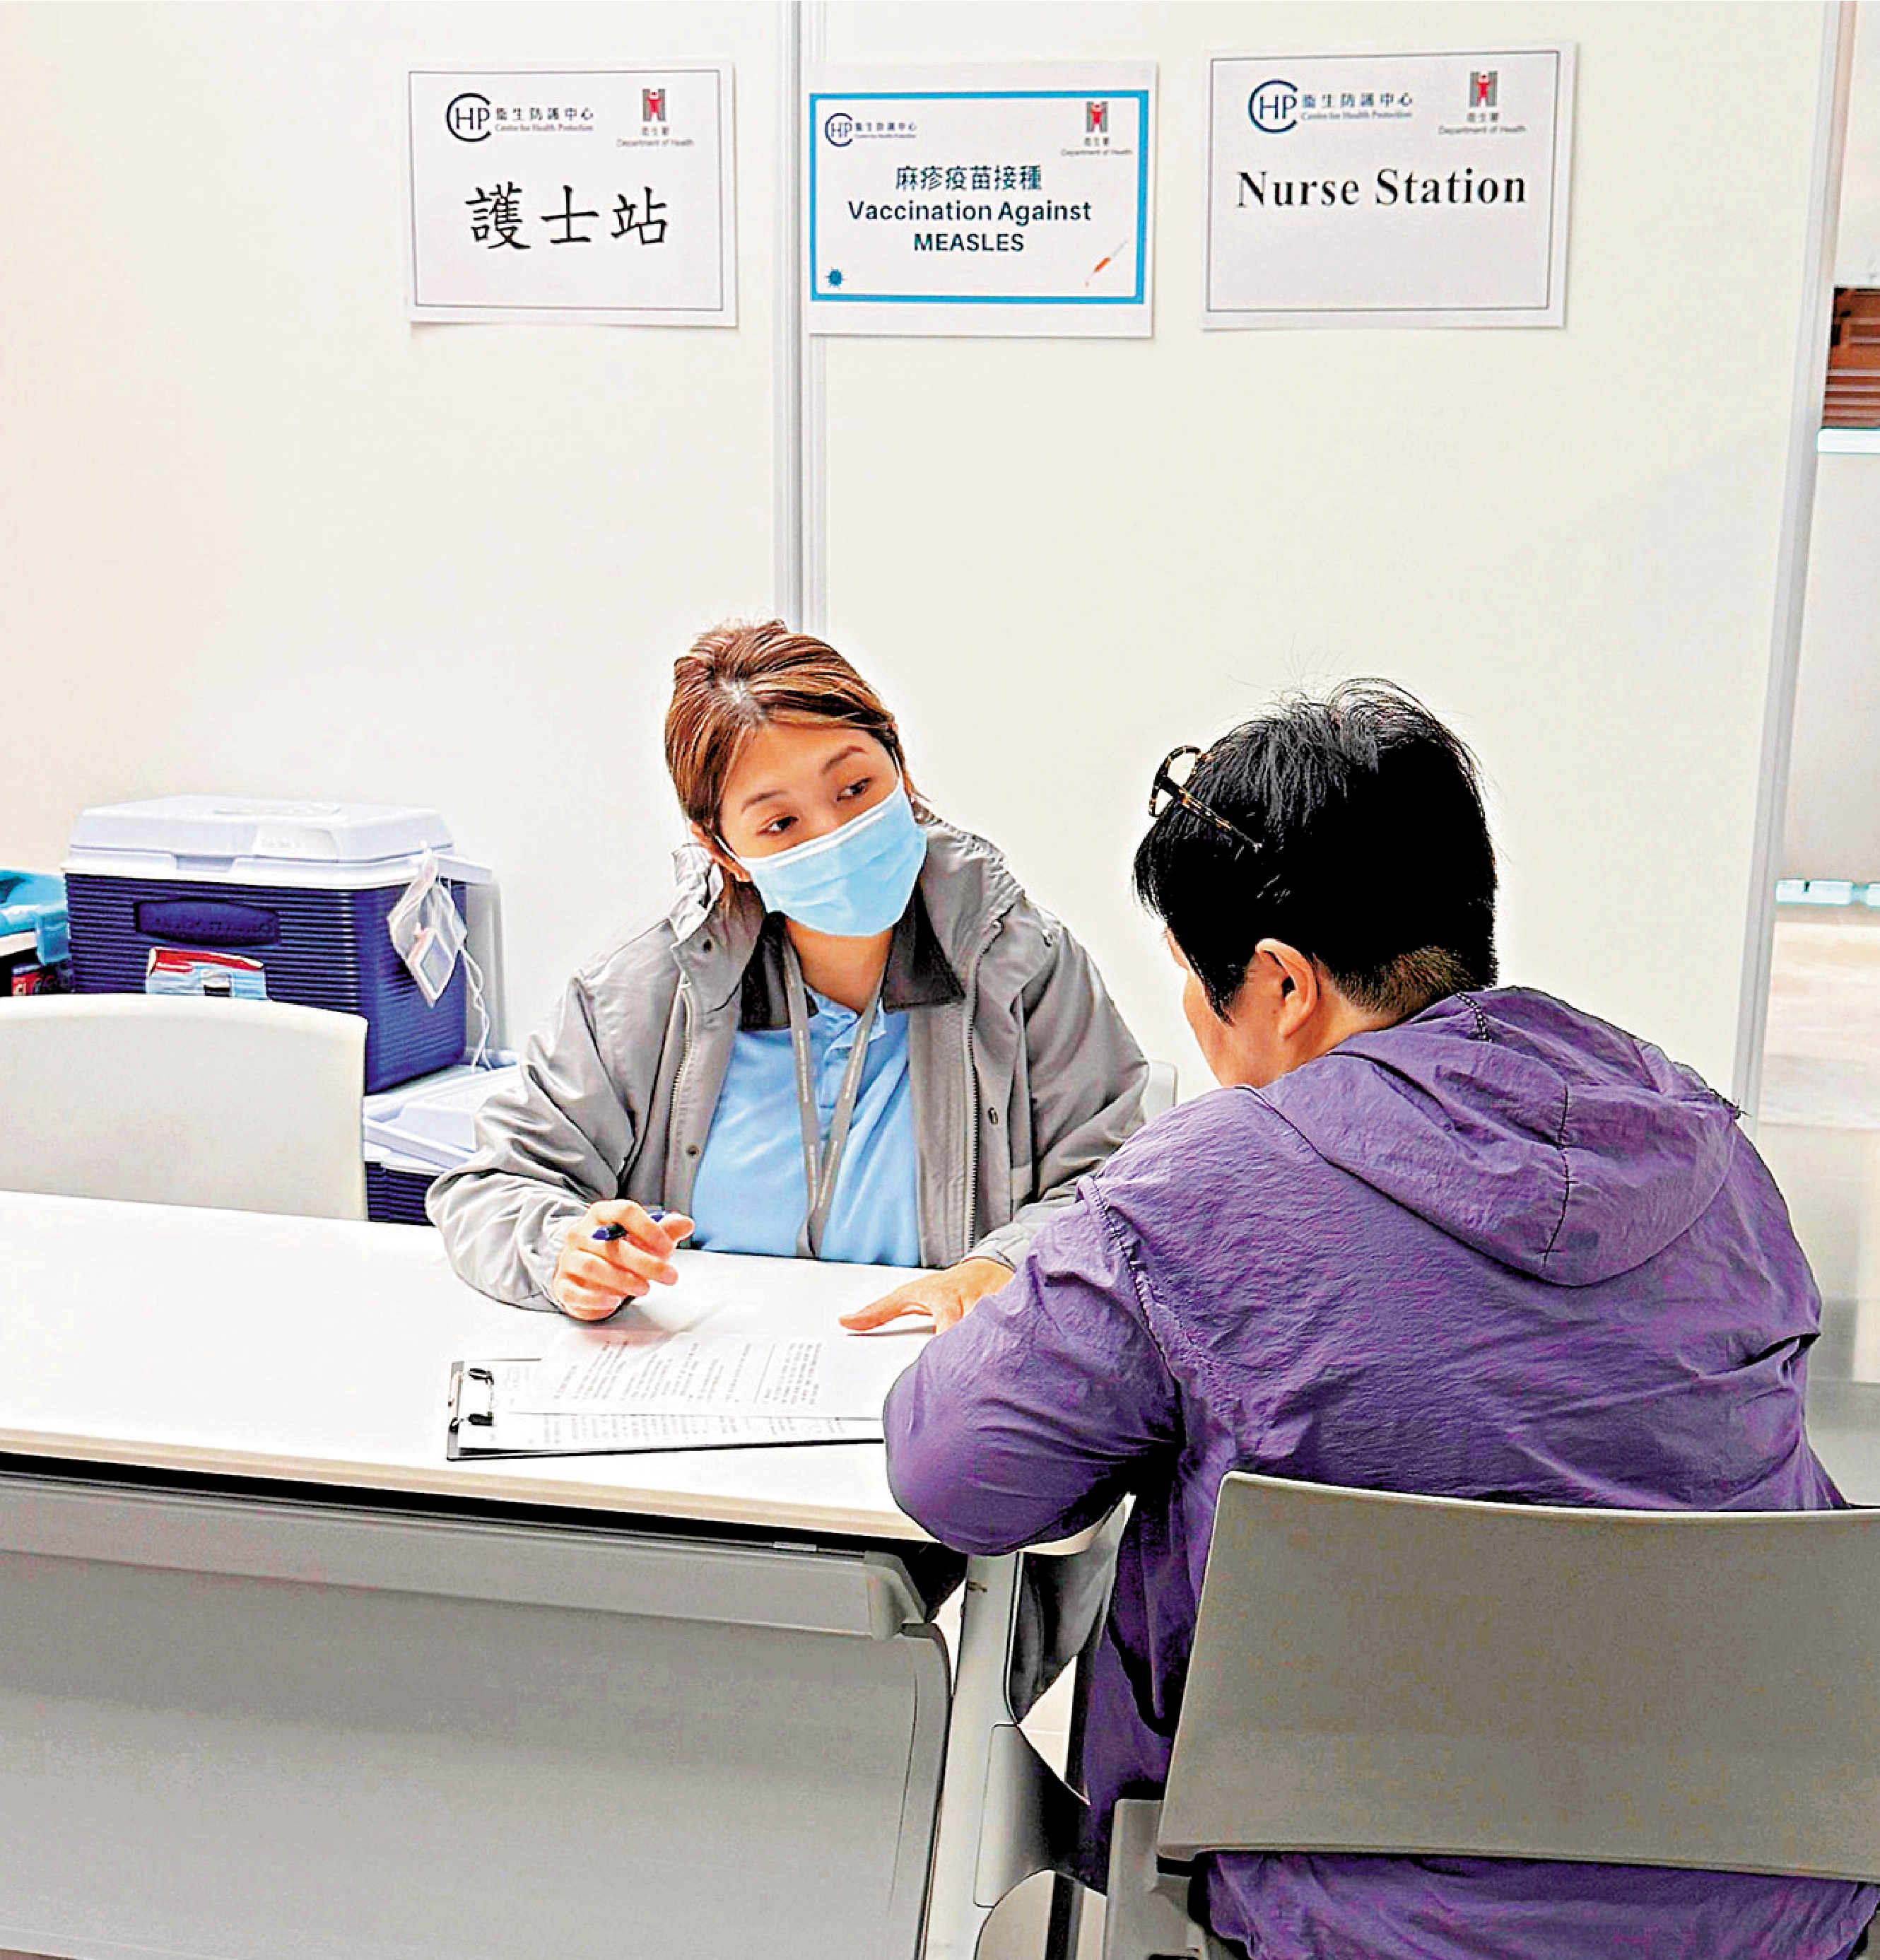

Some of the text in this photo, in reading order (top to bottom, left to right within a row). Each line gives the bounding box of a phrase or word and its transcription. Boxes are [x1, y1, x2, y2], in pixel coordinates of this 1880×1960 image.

[895, 164, 1042, 192] 麻疹疫苗接種
[1236, 167, 1526, 209] Nurse Station
[464, 180, 667, 250] 護士站
[848, 200, 1092, 227] Vaccination Against
[913, 233, 1024, 252] MEASLES
